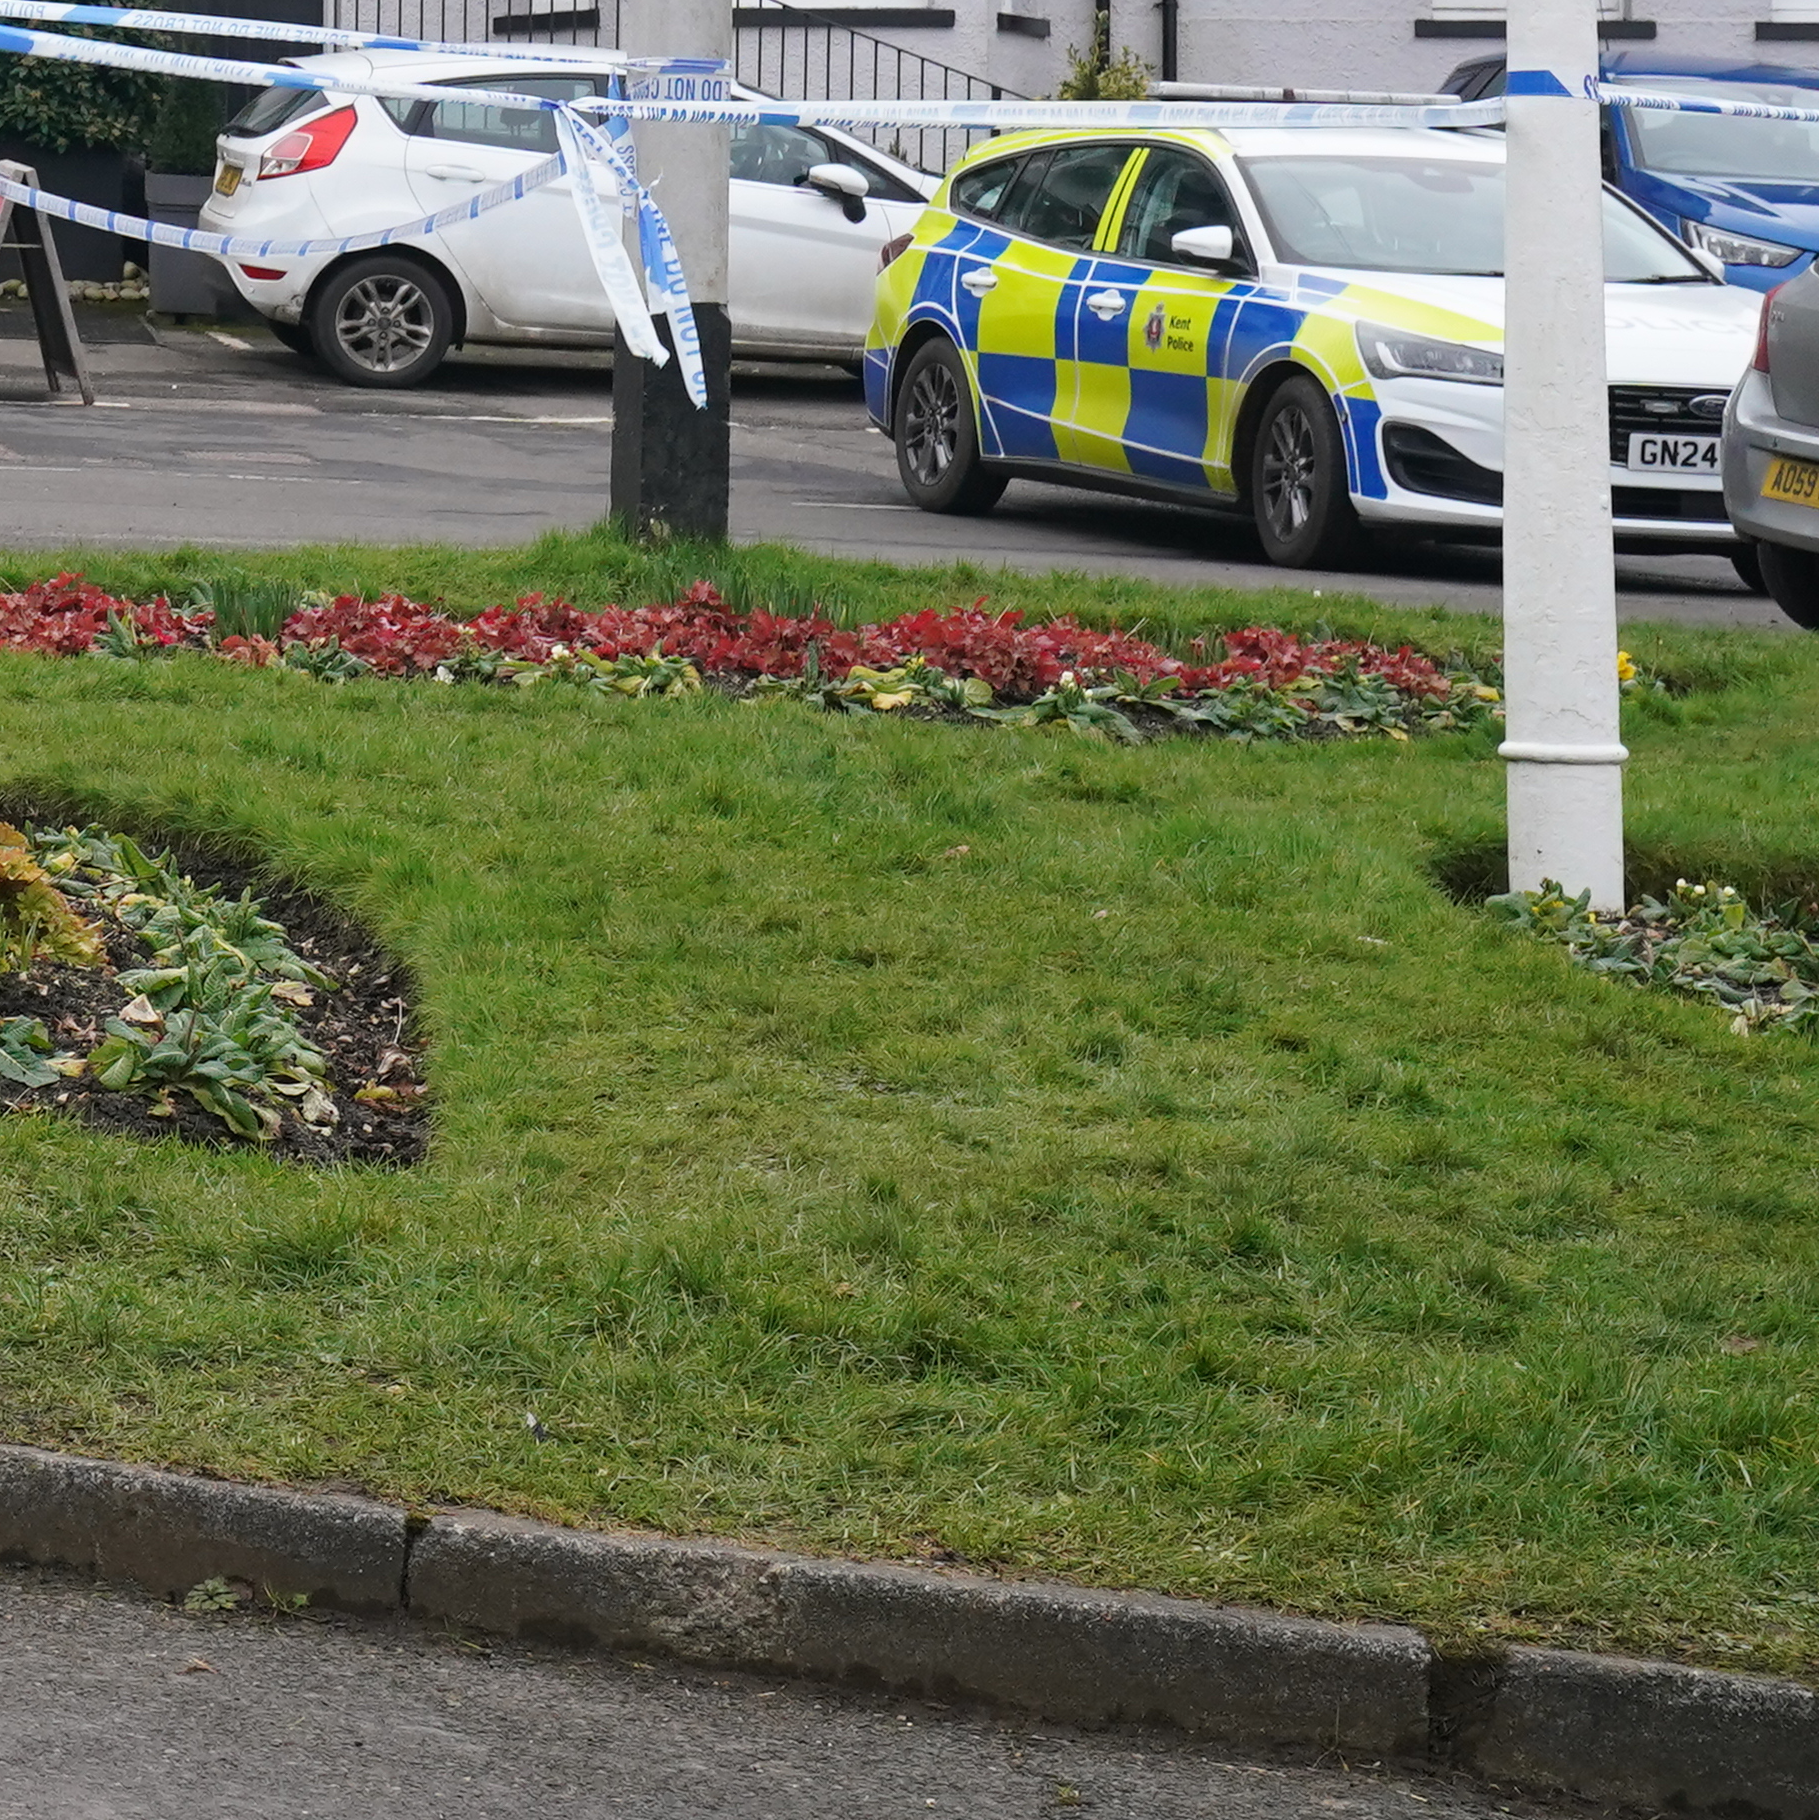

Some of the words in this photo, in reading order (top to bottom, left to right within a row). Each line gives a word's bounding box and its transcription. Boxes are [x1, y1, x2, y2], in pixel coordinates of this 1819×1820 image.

[1169, 315, 1191, 331] Kent
[1166, 335, 1195, 353] Police
[1640, 439, 1718, 469] GN24
